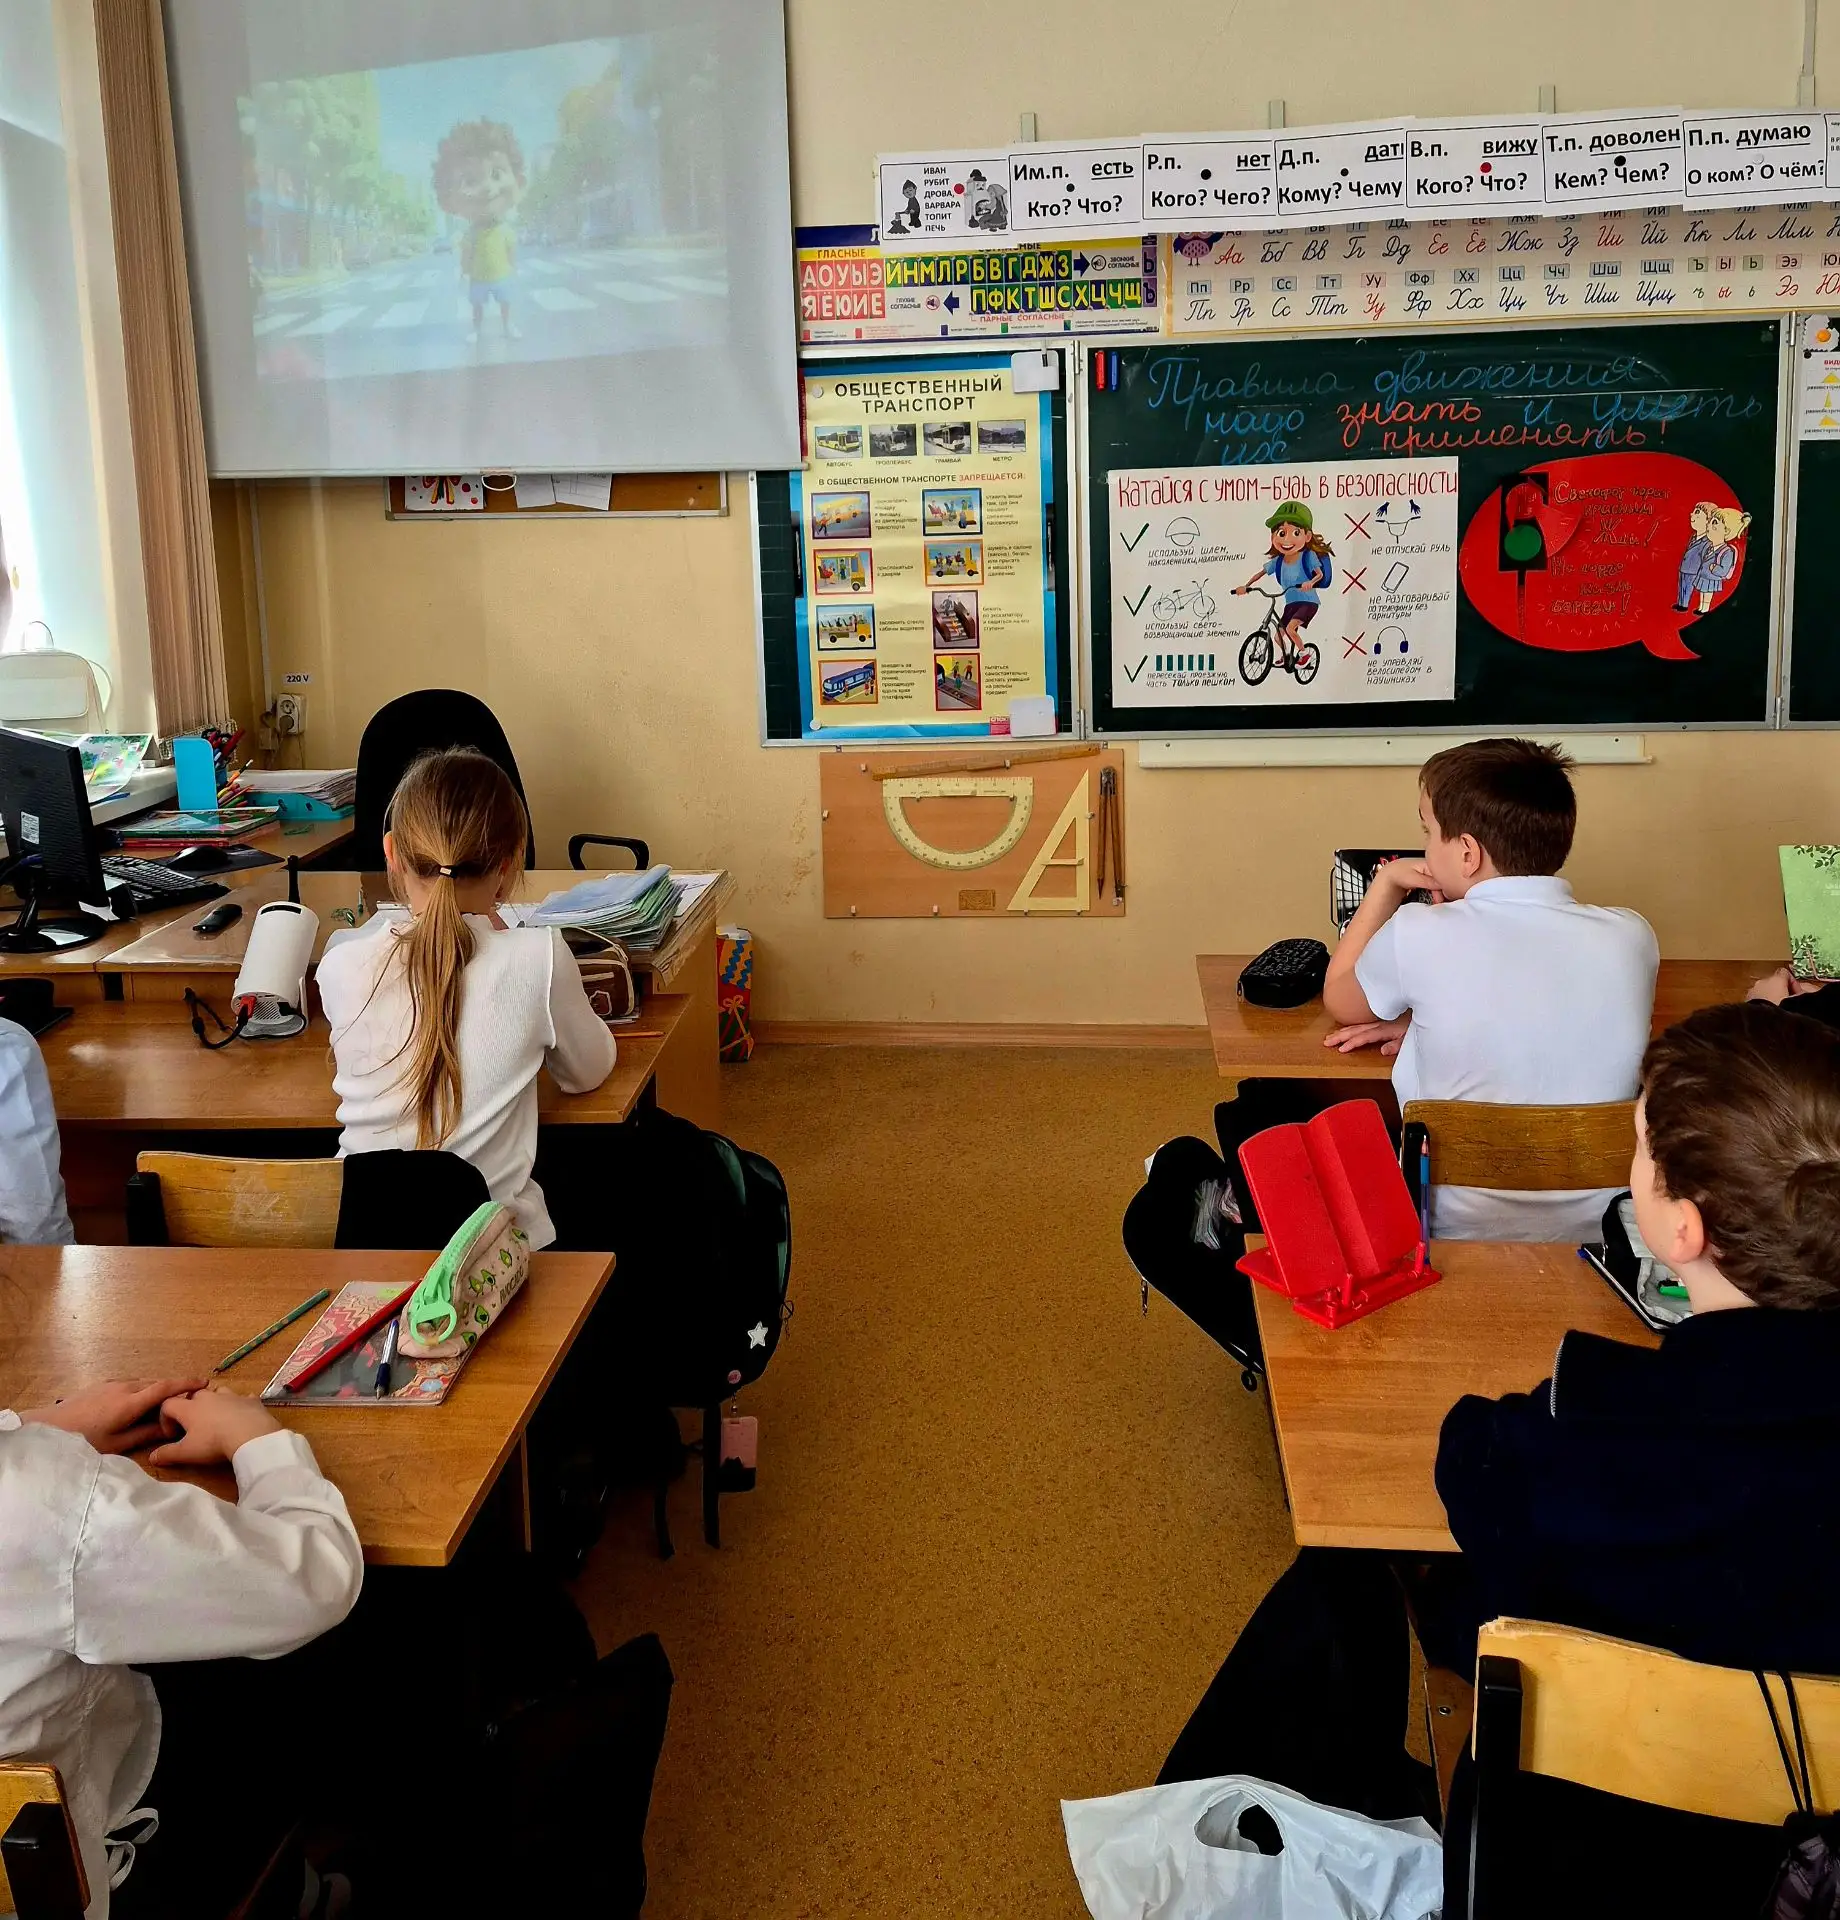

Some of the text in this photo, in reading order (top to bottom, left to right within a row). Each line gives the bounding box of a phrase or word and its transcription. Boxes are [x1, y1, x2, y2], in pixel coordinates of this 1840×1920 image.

[1546, 126, 1681, 152] Т.п. доволен
[1736, 125, 1812, 147] думаю
[1410, 138, 1538, 158] В.п. вижу
[1147, 154, 1271, 170] Р.п. нет
[1279, 150, 1320, 170] Д.п.
[923, 167, 947, 175] ИВАН
[1014, 160, 1134, 181] Им.п. есть
[1555, 163, 1670, 189] Кем? Чем?
[1688, 160, 1824, 184] О ком? О чём?
[924, 178, 950, 186] РУБИТ
[1279, 180, 1402, 204] Кому? Чему
[1416, 172, 1527, 195] Кого? Что?
[924, 190, 955, 199] ДРОВА,
[1151, 187, 1270, 207] Кого? Чего?
[925, 201, 961, 210] ВАРВАРА
[1028, 195, 1123, 218] Кто? Что?
[925, 212, 952, 221] ТОПИТ
[925, 224, 946, 232] ПЕЧЬ
[817, 249, 866, 259] ГЛАСНЫЕ
[1190, 282, 1208, 294] Пп
[1234, 280, 1250, 293] Рр
[1277, 279, 1291, 290] Сс
[1321, 276, 1337, 288] Тт
[1366, 274, 1381, 287] Уу
[1409, 272, 1430, 285] Фф
[1459, 270, 1475, 281] Хх
[1502, 268, 1522, 282] Цц
[1548, 265, 1566, 277] Чч
[1593, 263, 1618, 275] Шш
[1644, 260, 1671, 274] Щщ
[1823, 254, 1840, 266] Ю
[1017, 313, 1065, 321] СОГЛАСНЫЕ
[834, 374, 1002, 398] ОБЩЕСТВЕННЫЙ
[1149, 349, 1642, 432] Правила движения
[862, 397, 976, 414] ТРАНСПОРТ
[1205, 409, 1305, 441] надо
[1337, 400, 1484, 448] знать
[826, 476, 899, 486] ОБЩЕСТВЕННОМ
[901, 474, 957, 483] ТРАНСПОРТЕ
[959, 472, 1026, 482] ЗАПРЕЩАЕТСЯ:
[286, 675, 301, 683] 220
